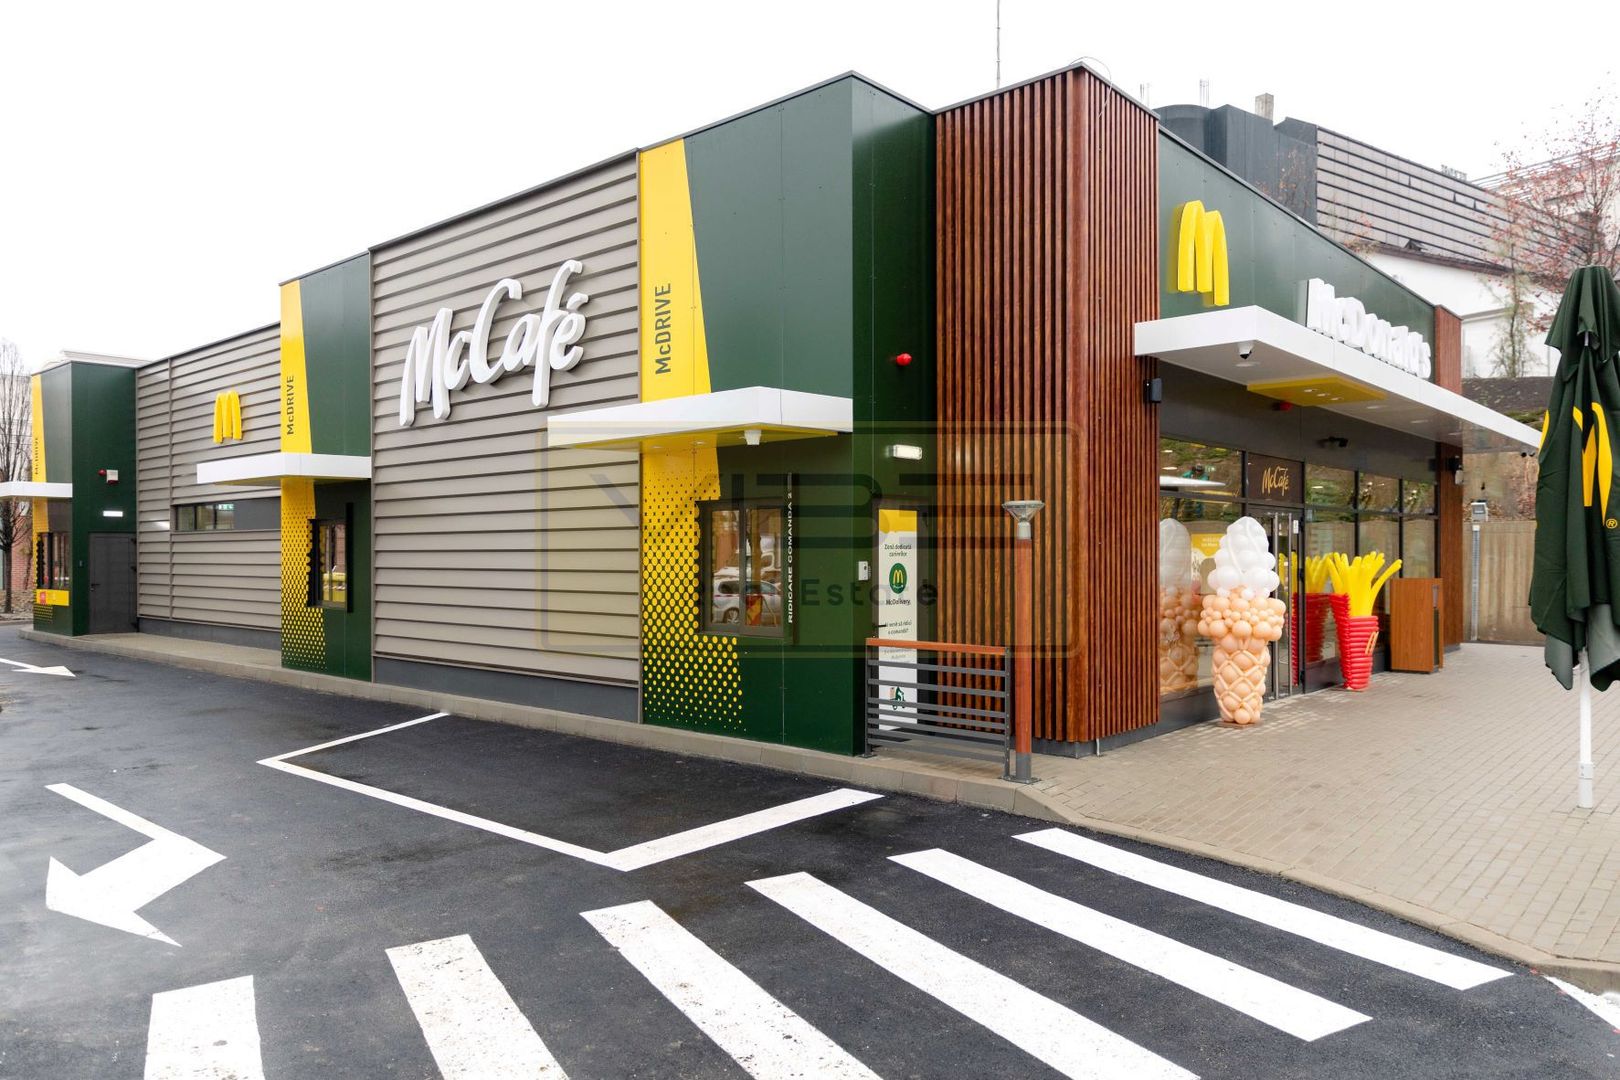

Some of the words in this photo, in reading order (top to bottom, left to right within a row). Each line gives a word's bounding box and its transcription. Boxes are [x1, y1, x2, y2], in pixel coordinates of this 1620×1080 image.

[399, 259, 589, 426] McCafé
[654, 283, 671, 374] McDRIVE
[286, 375, 295, 435] McDRIVE
[1262, 466, 1289, 496] McCafé
